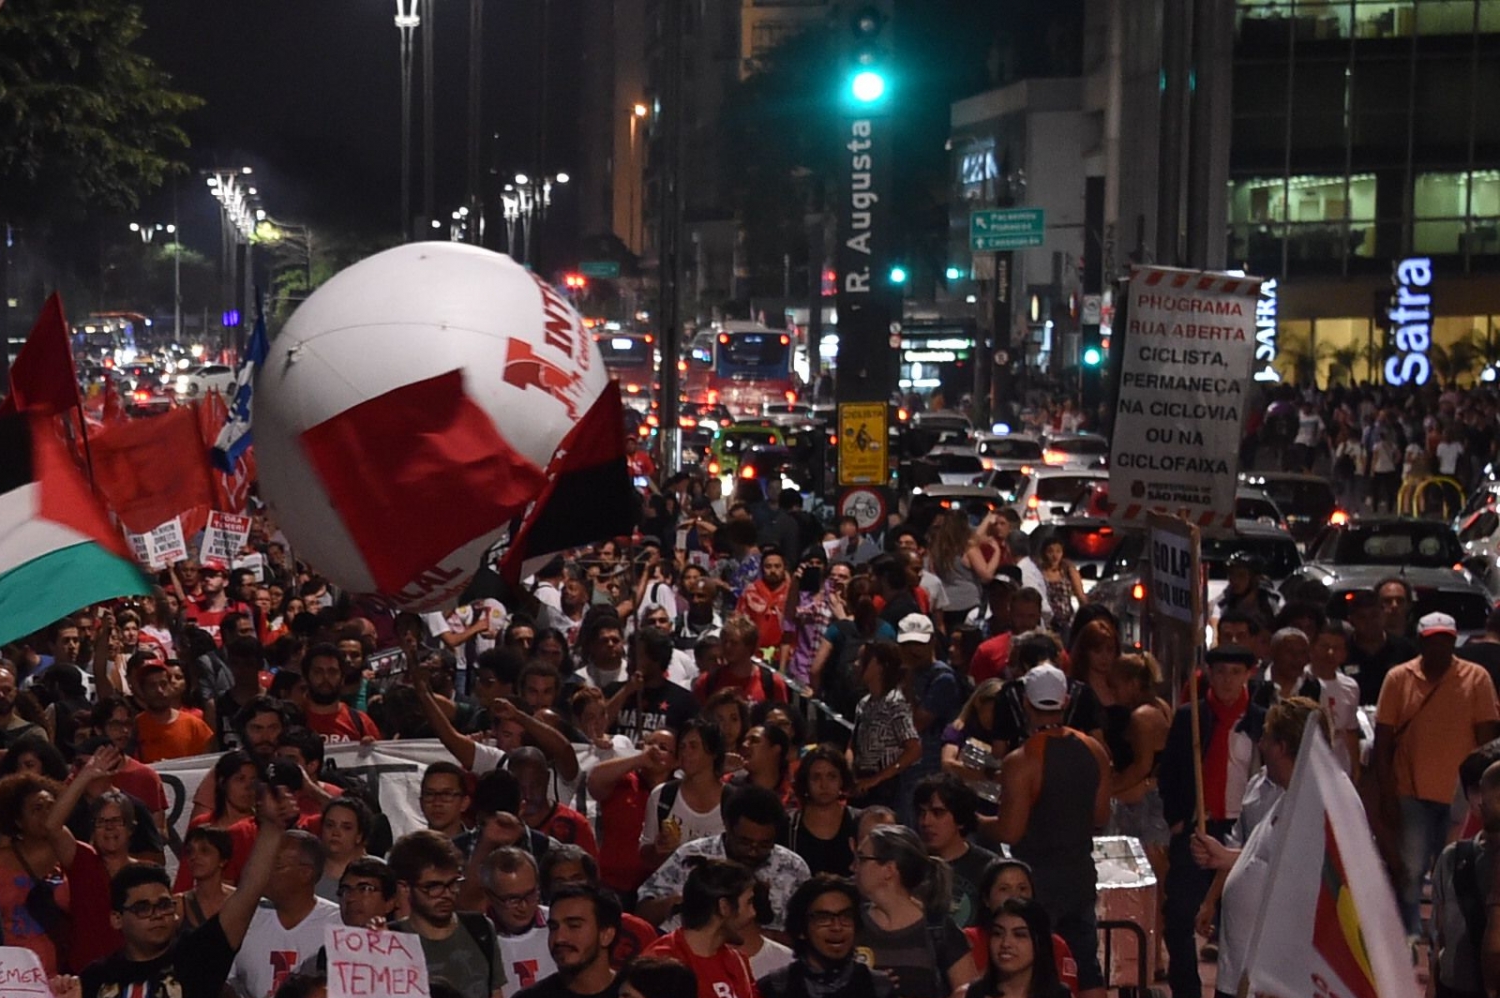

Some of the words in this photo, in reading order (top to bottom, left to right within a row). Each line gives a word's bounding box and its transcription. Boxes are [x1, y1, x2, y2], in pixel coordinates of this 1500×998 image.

[846, 119, 879, 255] Augusta
[845, 266, 870, 293] R.
[1138, 294, 1243, 317] PROGRAMA
[1129, 319, 1167, 338] RUA
[1173, 323, 1246, 342] ABERTA
[1385, 257, 1432, 386] Safra
[1139, 346, 1229, 369] CICLISTA,
[1122, 372, 1241, 396] PERMANEÇA
[1119, 399, 1145, 415] NA
[1149, 401, 1238, 421] CICLOVIA
[1145, 427, 1173, 444] OU
[1179, 431, 1204, 446] NA
[1117, 453, 1229, 475] CICLOFAIXA
[1173, 491, 1212, 505] PAULO
[1153, 541, 1192, 580] GOLP
[332, 929, 414, 960] FORA
[331, 962, 427, 996] TEMER
